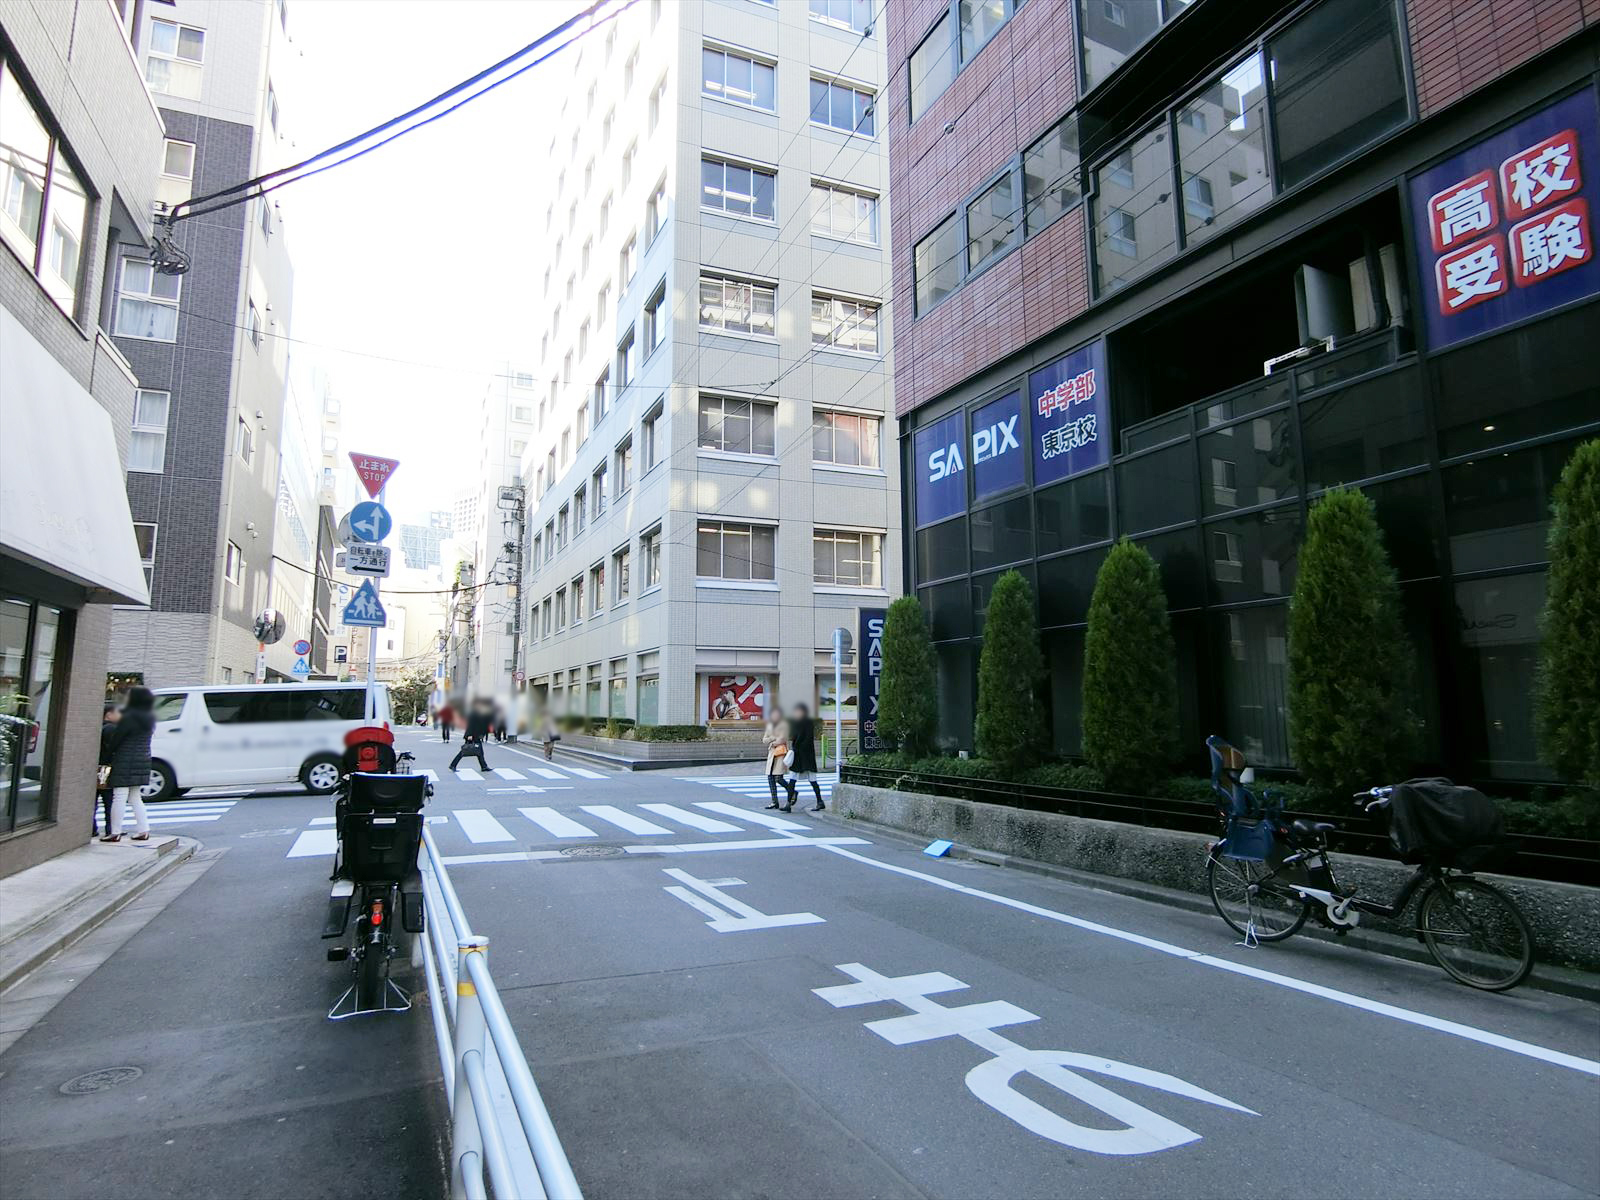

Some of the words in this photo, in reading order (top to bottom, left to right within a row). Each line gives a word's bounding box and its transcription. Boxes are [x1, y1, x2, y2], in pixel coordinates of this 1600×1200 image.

[1436, 143, 1575, 246] 高校
[1445, 212, 1586, 308] 受験
[1037, 368, 1097, 418] 中学部
[1041, 413, 1097, 460] 東京校
[360, 459, 390, 473] 止まれ
[363, 471, 386, 482] STOP
[350, 556, 388, 567] 一方通行
[336, 647, 347, 659] P
